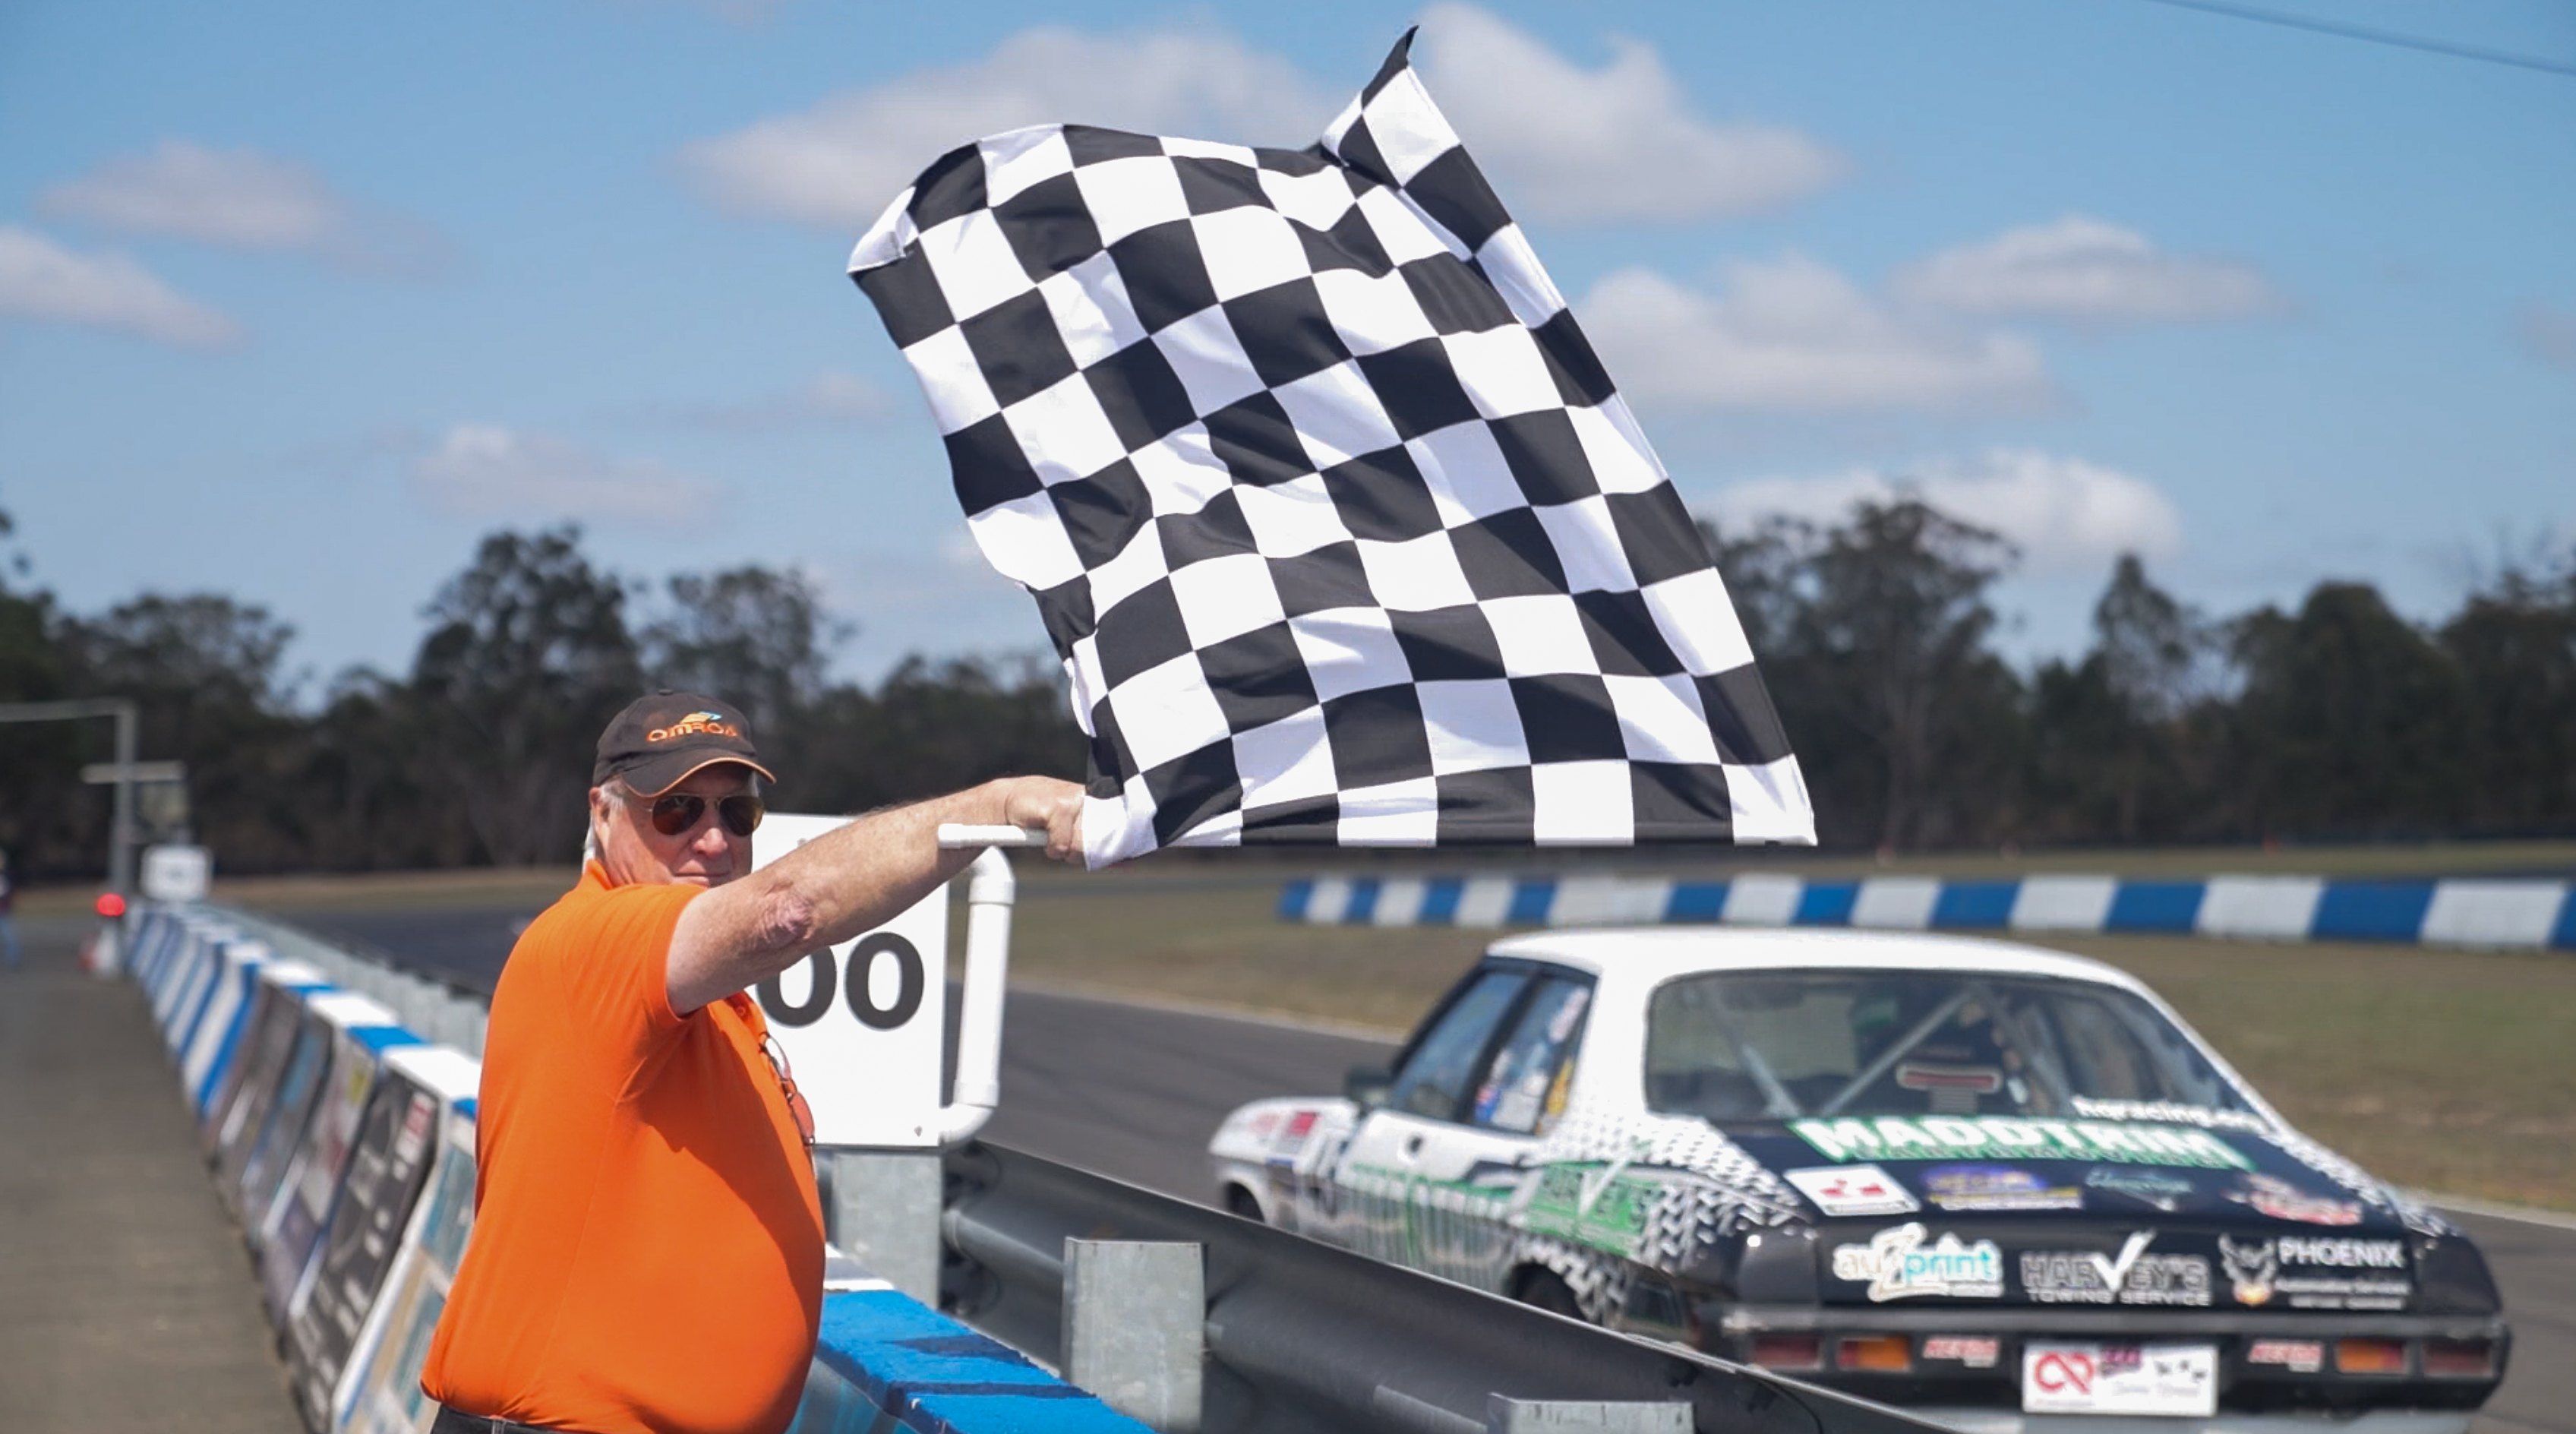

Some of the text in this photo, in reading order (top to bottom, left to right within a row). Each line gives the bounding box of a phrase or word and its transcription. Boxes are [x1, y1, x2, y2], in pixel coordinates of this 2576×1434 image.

[1795, 1117, 2254, 1170] MADDTRIM
[2019, 1228, 2209, 1293] HARVEY'S
[2278, 1237, 2405, 1268] PHOENIX
[2025, 1289, 2211, 1307] TOWING SERVICE
